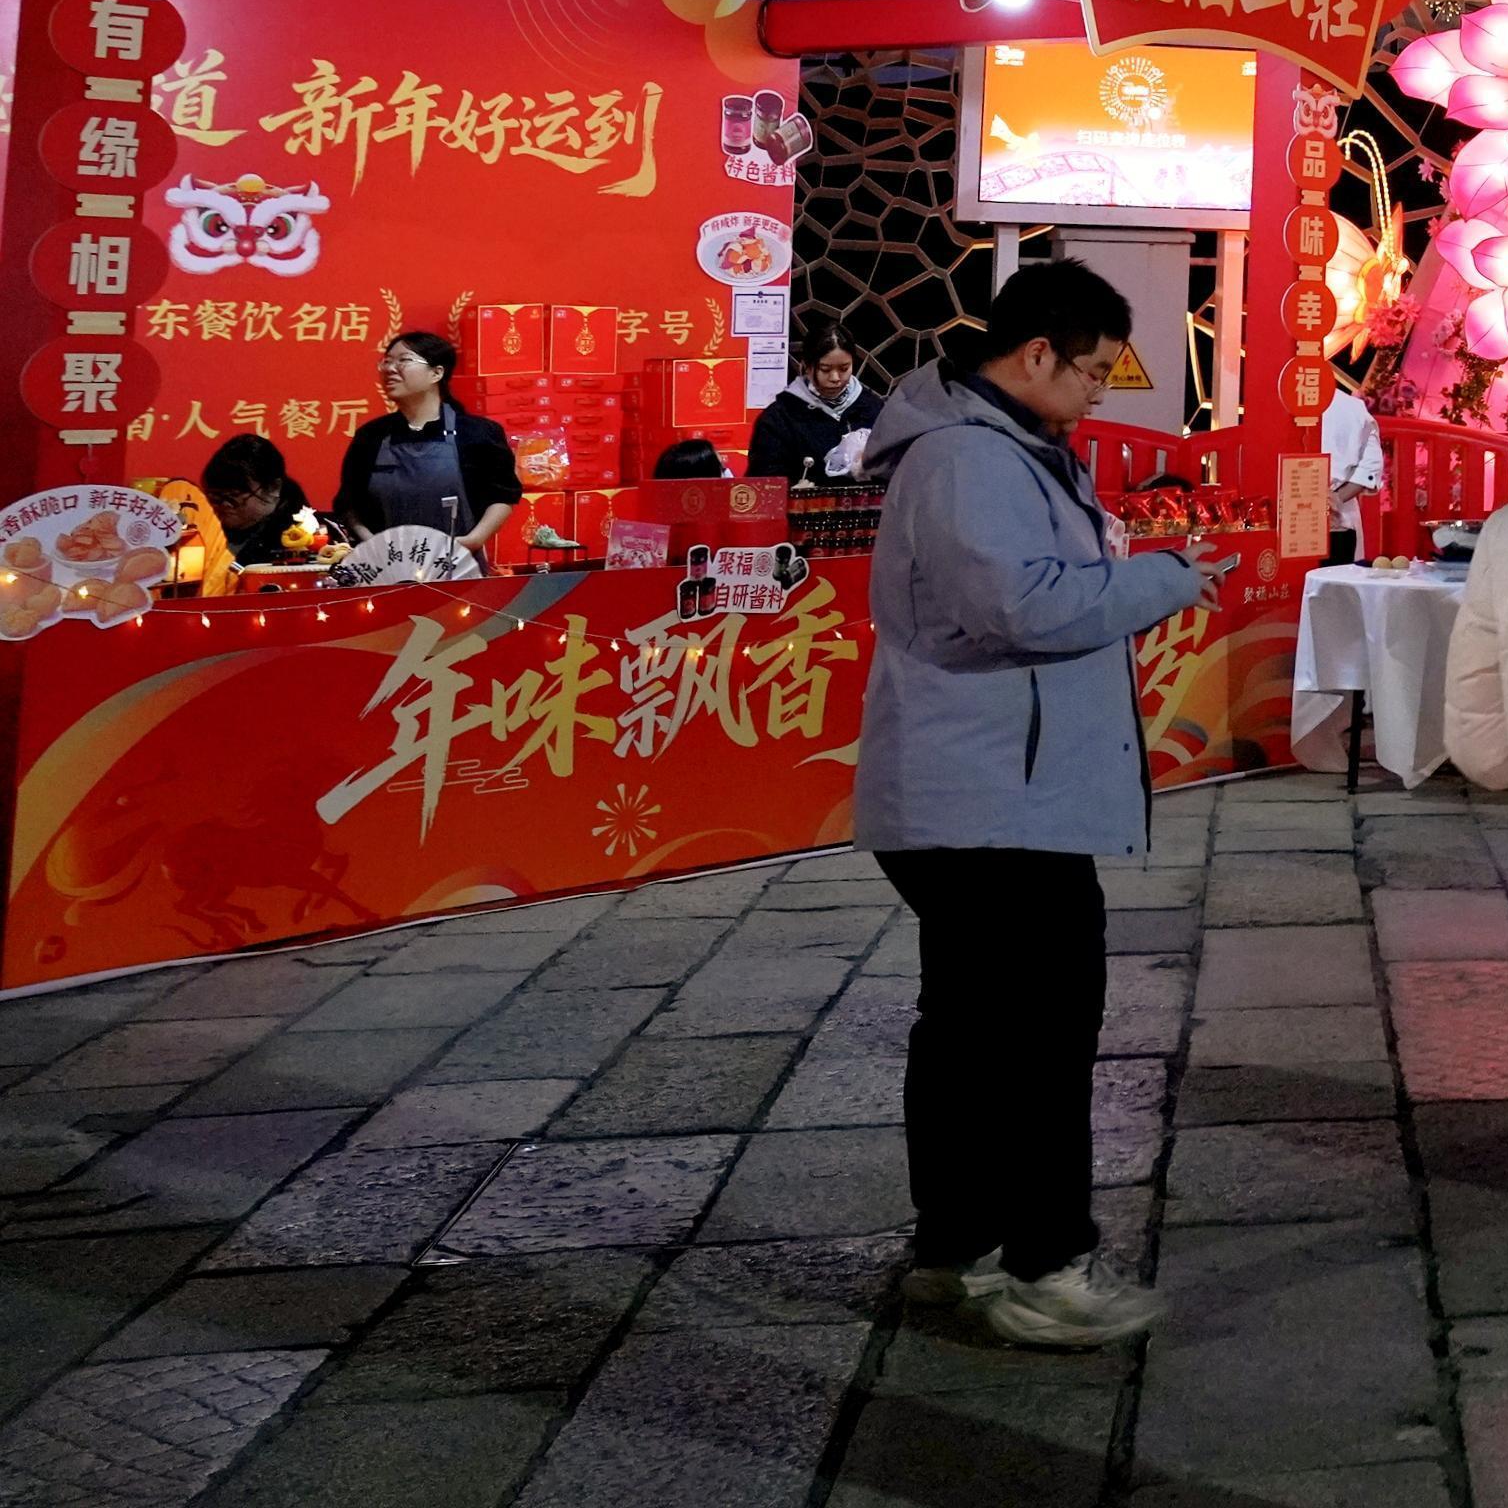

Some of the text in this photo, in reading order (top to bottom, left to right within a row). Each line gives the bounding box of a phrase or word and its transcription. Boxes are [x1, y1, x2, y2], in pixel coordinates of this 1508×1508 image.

[259, 59, 664, 197] 新年好运到
[1295, 140, 1326, 407] 品味幸福
[617, 309, 694, 344] 字号
[0, 488, 178, 542] 香酥脆口 新年好兆头
[718, 550, 754, 577] 聚福
[714, 583, 784, 610] 自研酱料
[316, 576, 860, 847] 年味飘香
